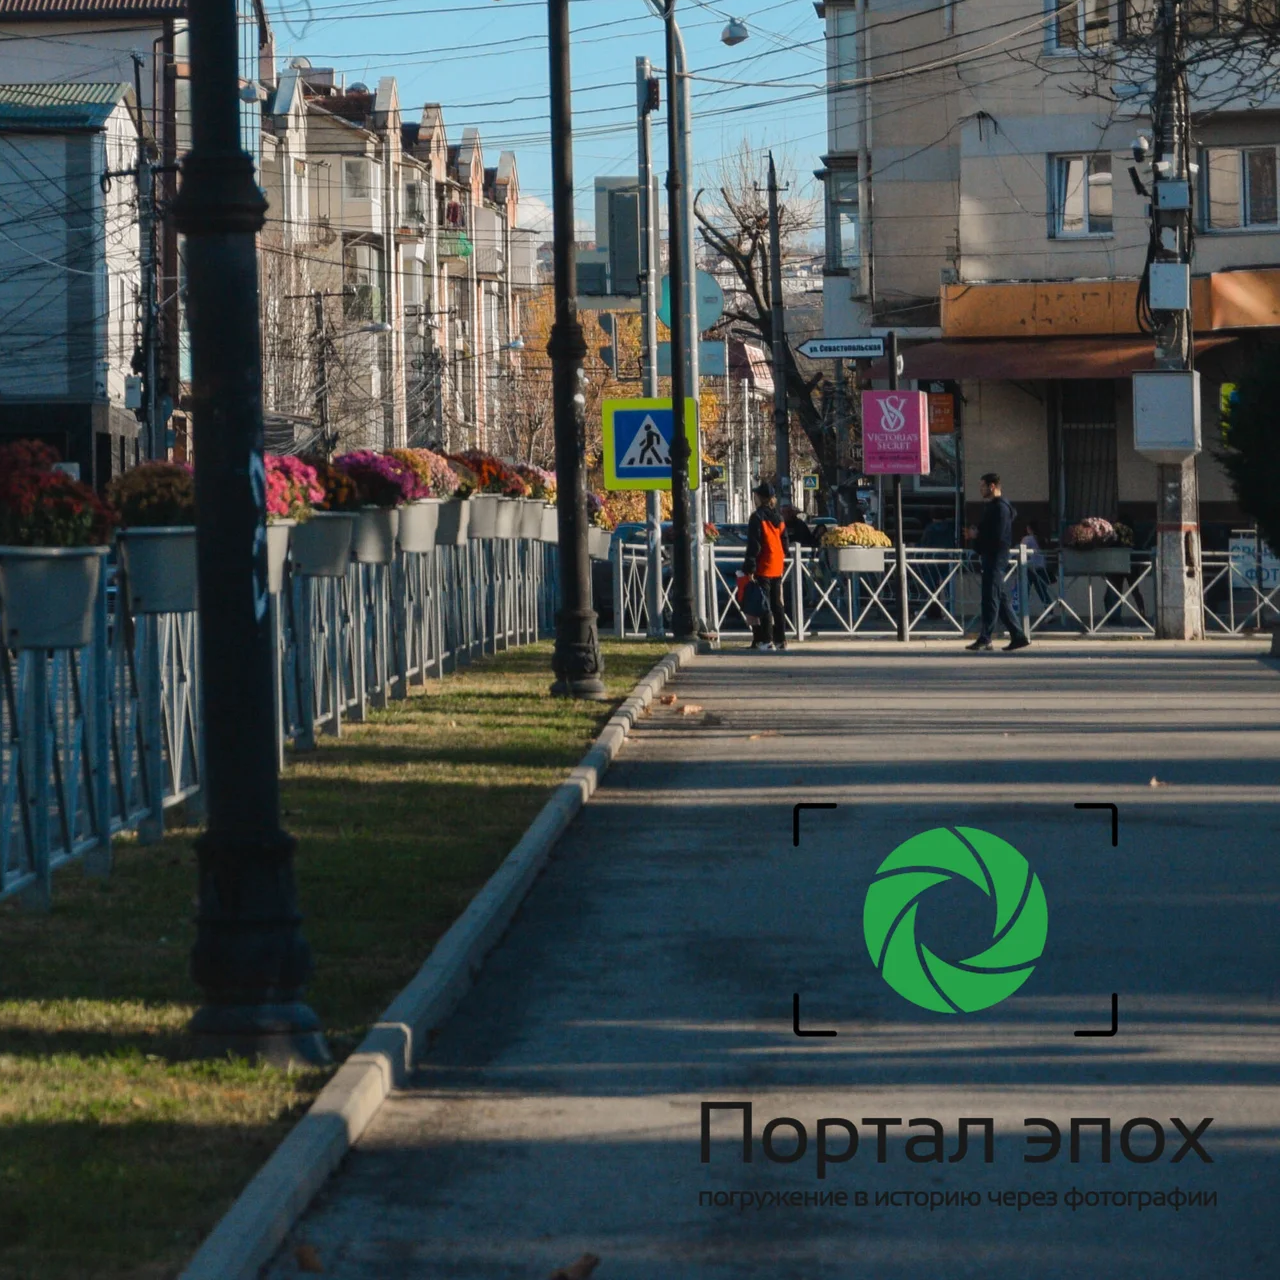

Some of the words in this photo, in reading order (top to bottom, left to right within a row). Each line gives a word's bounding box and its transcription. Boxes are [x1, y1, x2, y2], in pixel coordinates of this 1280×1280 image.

[819, 343, 882, 353] Севастопольская
[867, 432, 918, 442] VICTORIA'S
[876, 442, 911, 451] SECRET
